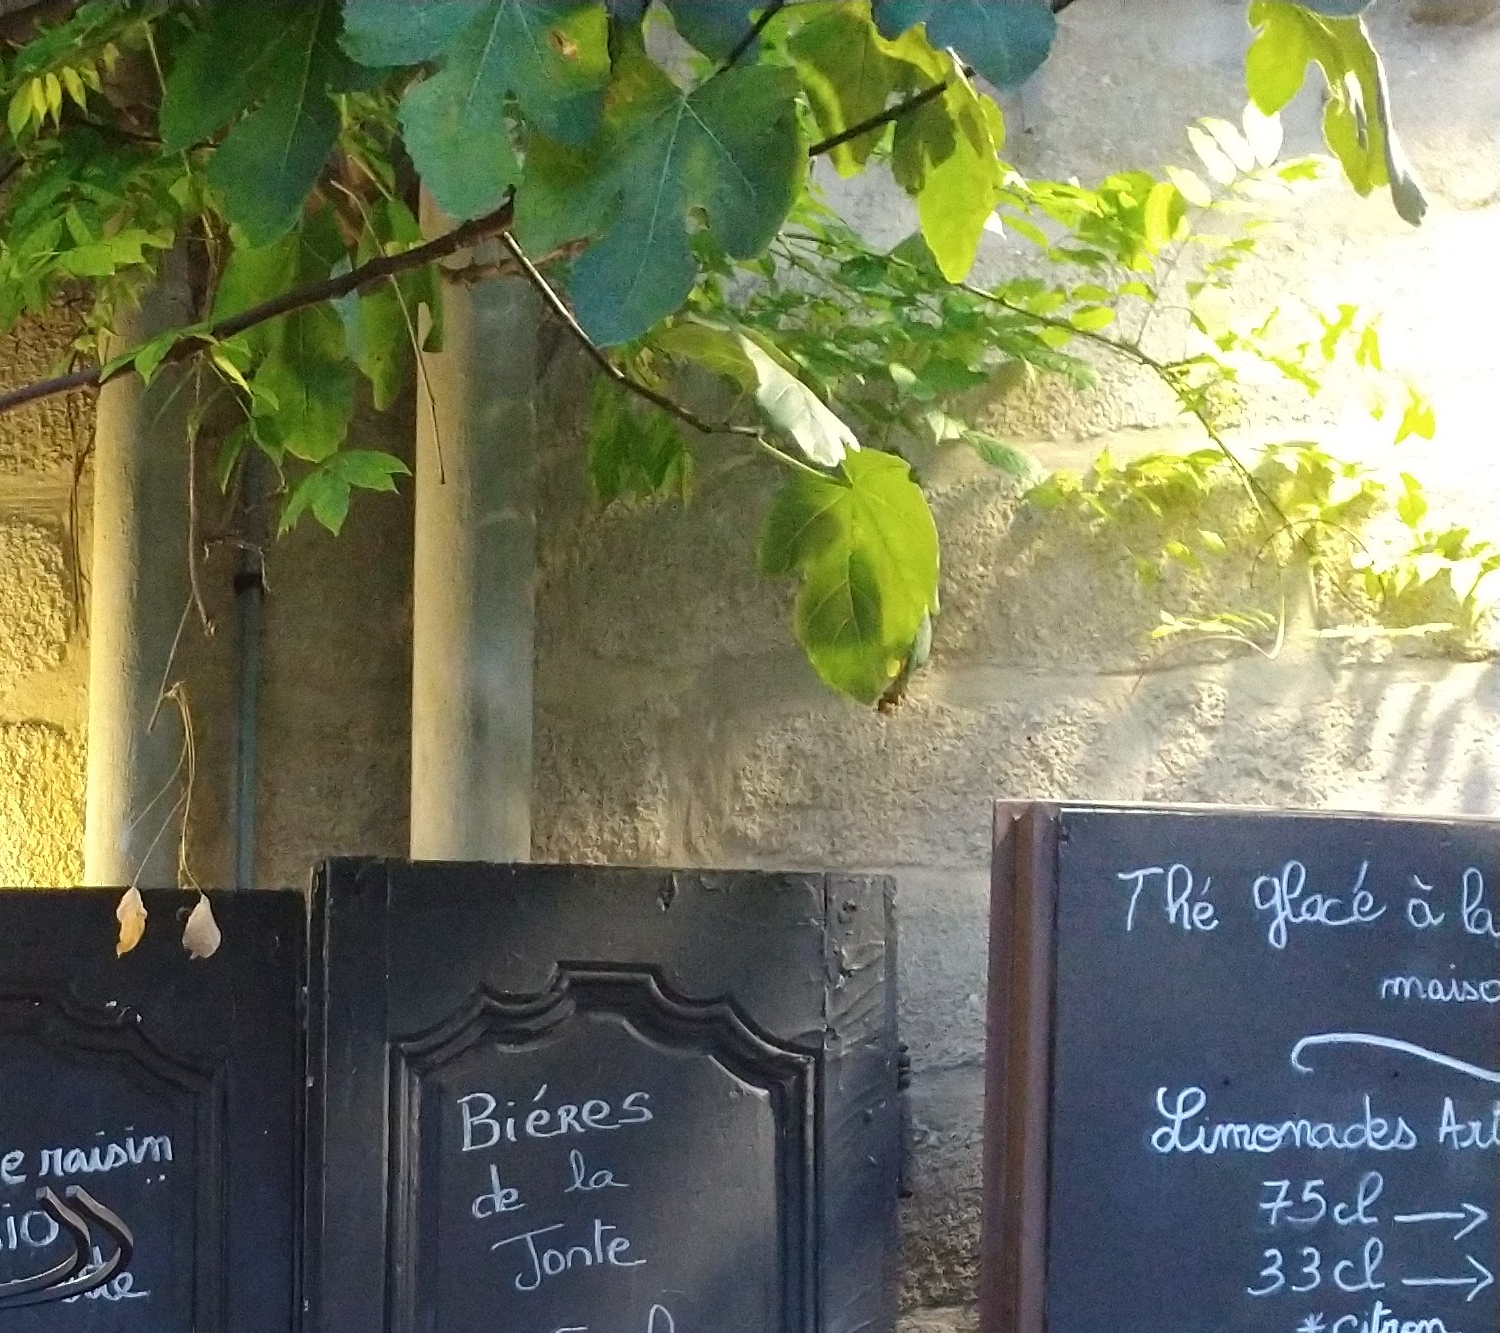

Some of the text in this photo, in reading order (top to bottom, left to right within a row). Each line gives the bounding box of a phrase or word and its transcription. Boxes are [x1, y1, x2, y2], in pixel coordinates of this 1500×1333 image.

[1117, 860, 1500, 949] Thé glacé à la
[40, 1126, 173, 1177] raisin
[1150, 1085, 1417, 1155] Limonades
[471, 1149, 631, 1219] de la
